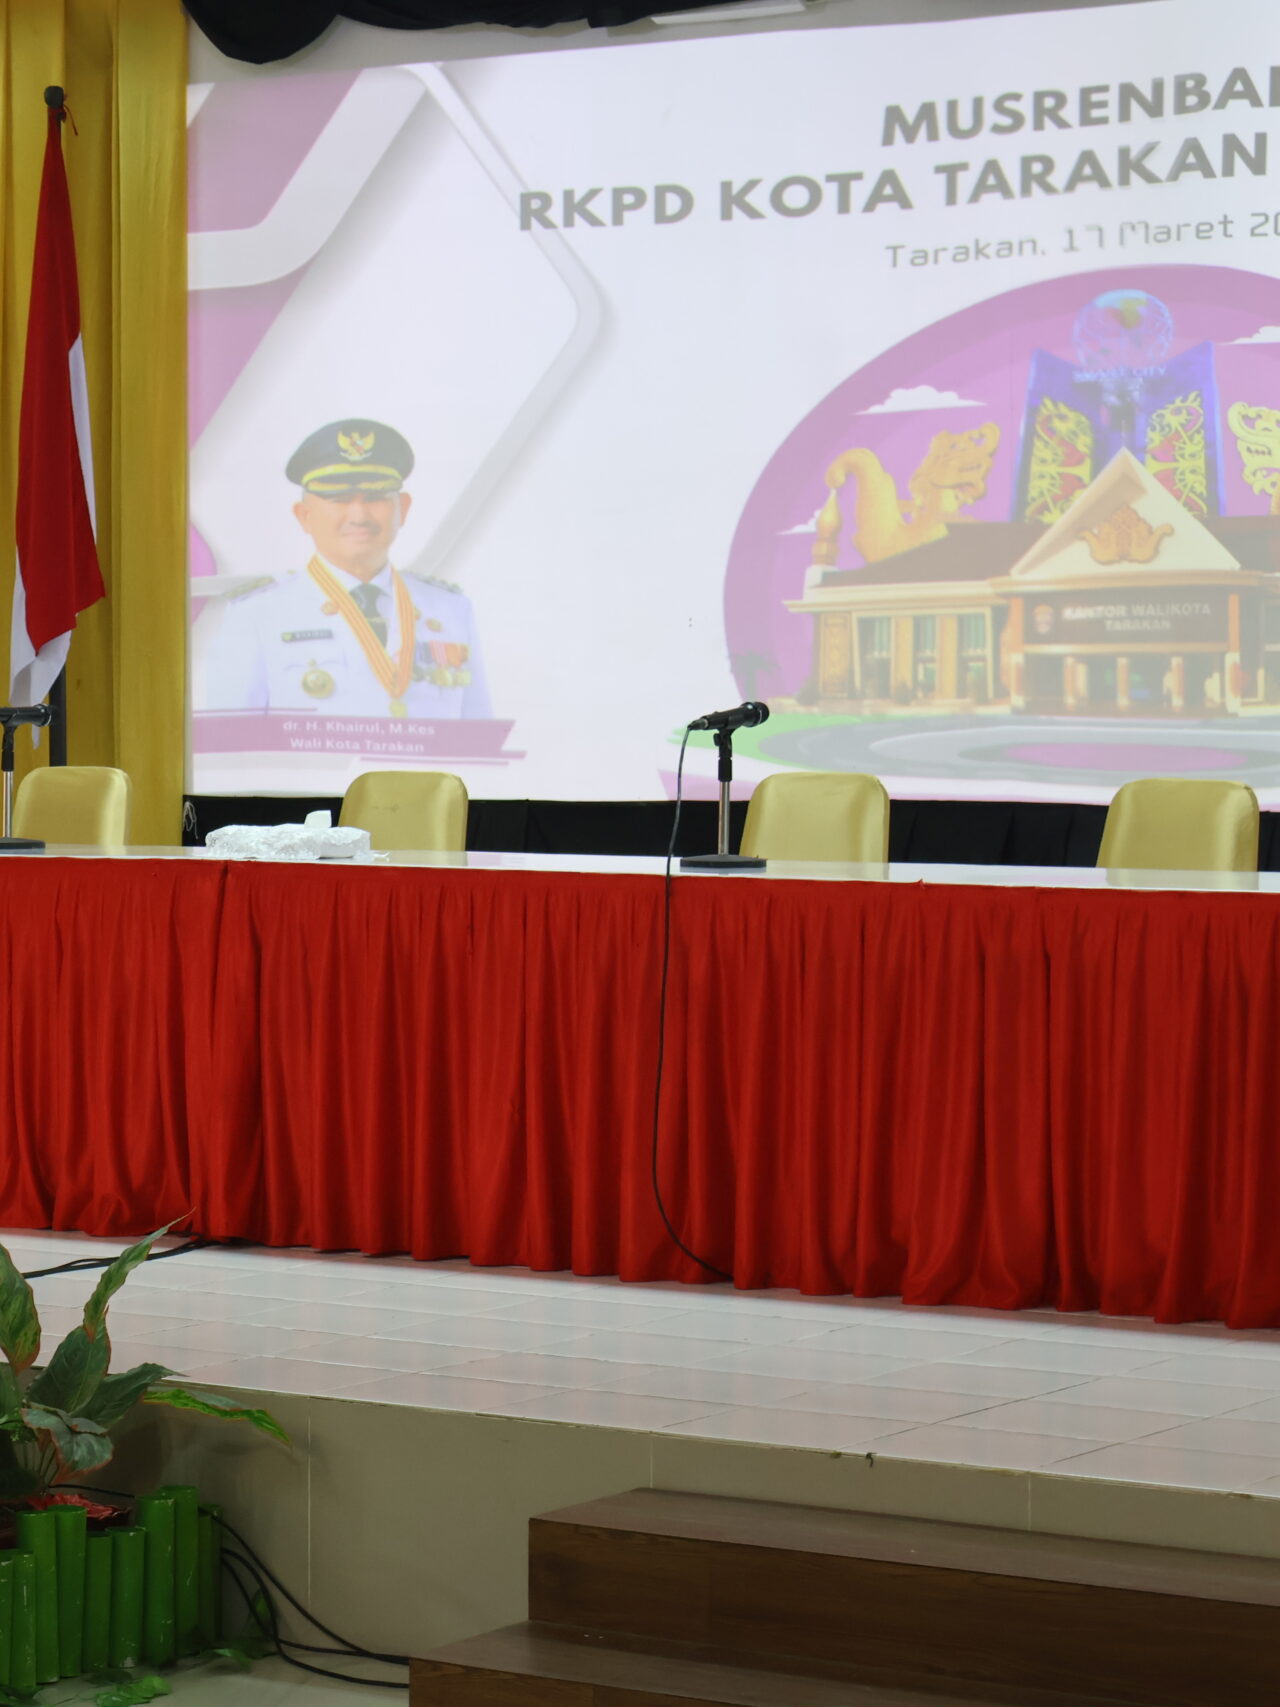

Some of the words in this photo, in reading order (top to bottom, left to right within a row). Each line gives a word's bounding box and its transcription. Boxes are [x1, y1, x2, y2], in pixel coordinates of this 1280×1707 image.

[881, 66, 1280, 147] MUSRENBA
[520, 184, 695, 231] RKPD
[720, 168, 914, 221] KOTA
[934, 132, 1268, 206] TARAKAN
[1120, 214, 1234, 246] Maret
[1131, 603, 1211, 617] WALIKOTA
[1104, 619, 1171, 631] TARAKAN
[290, 738, 320, 749] Wali
[326, 739, 360, 750] Kota
[365, 740, 425, 753] Tarakan
